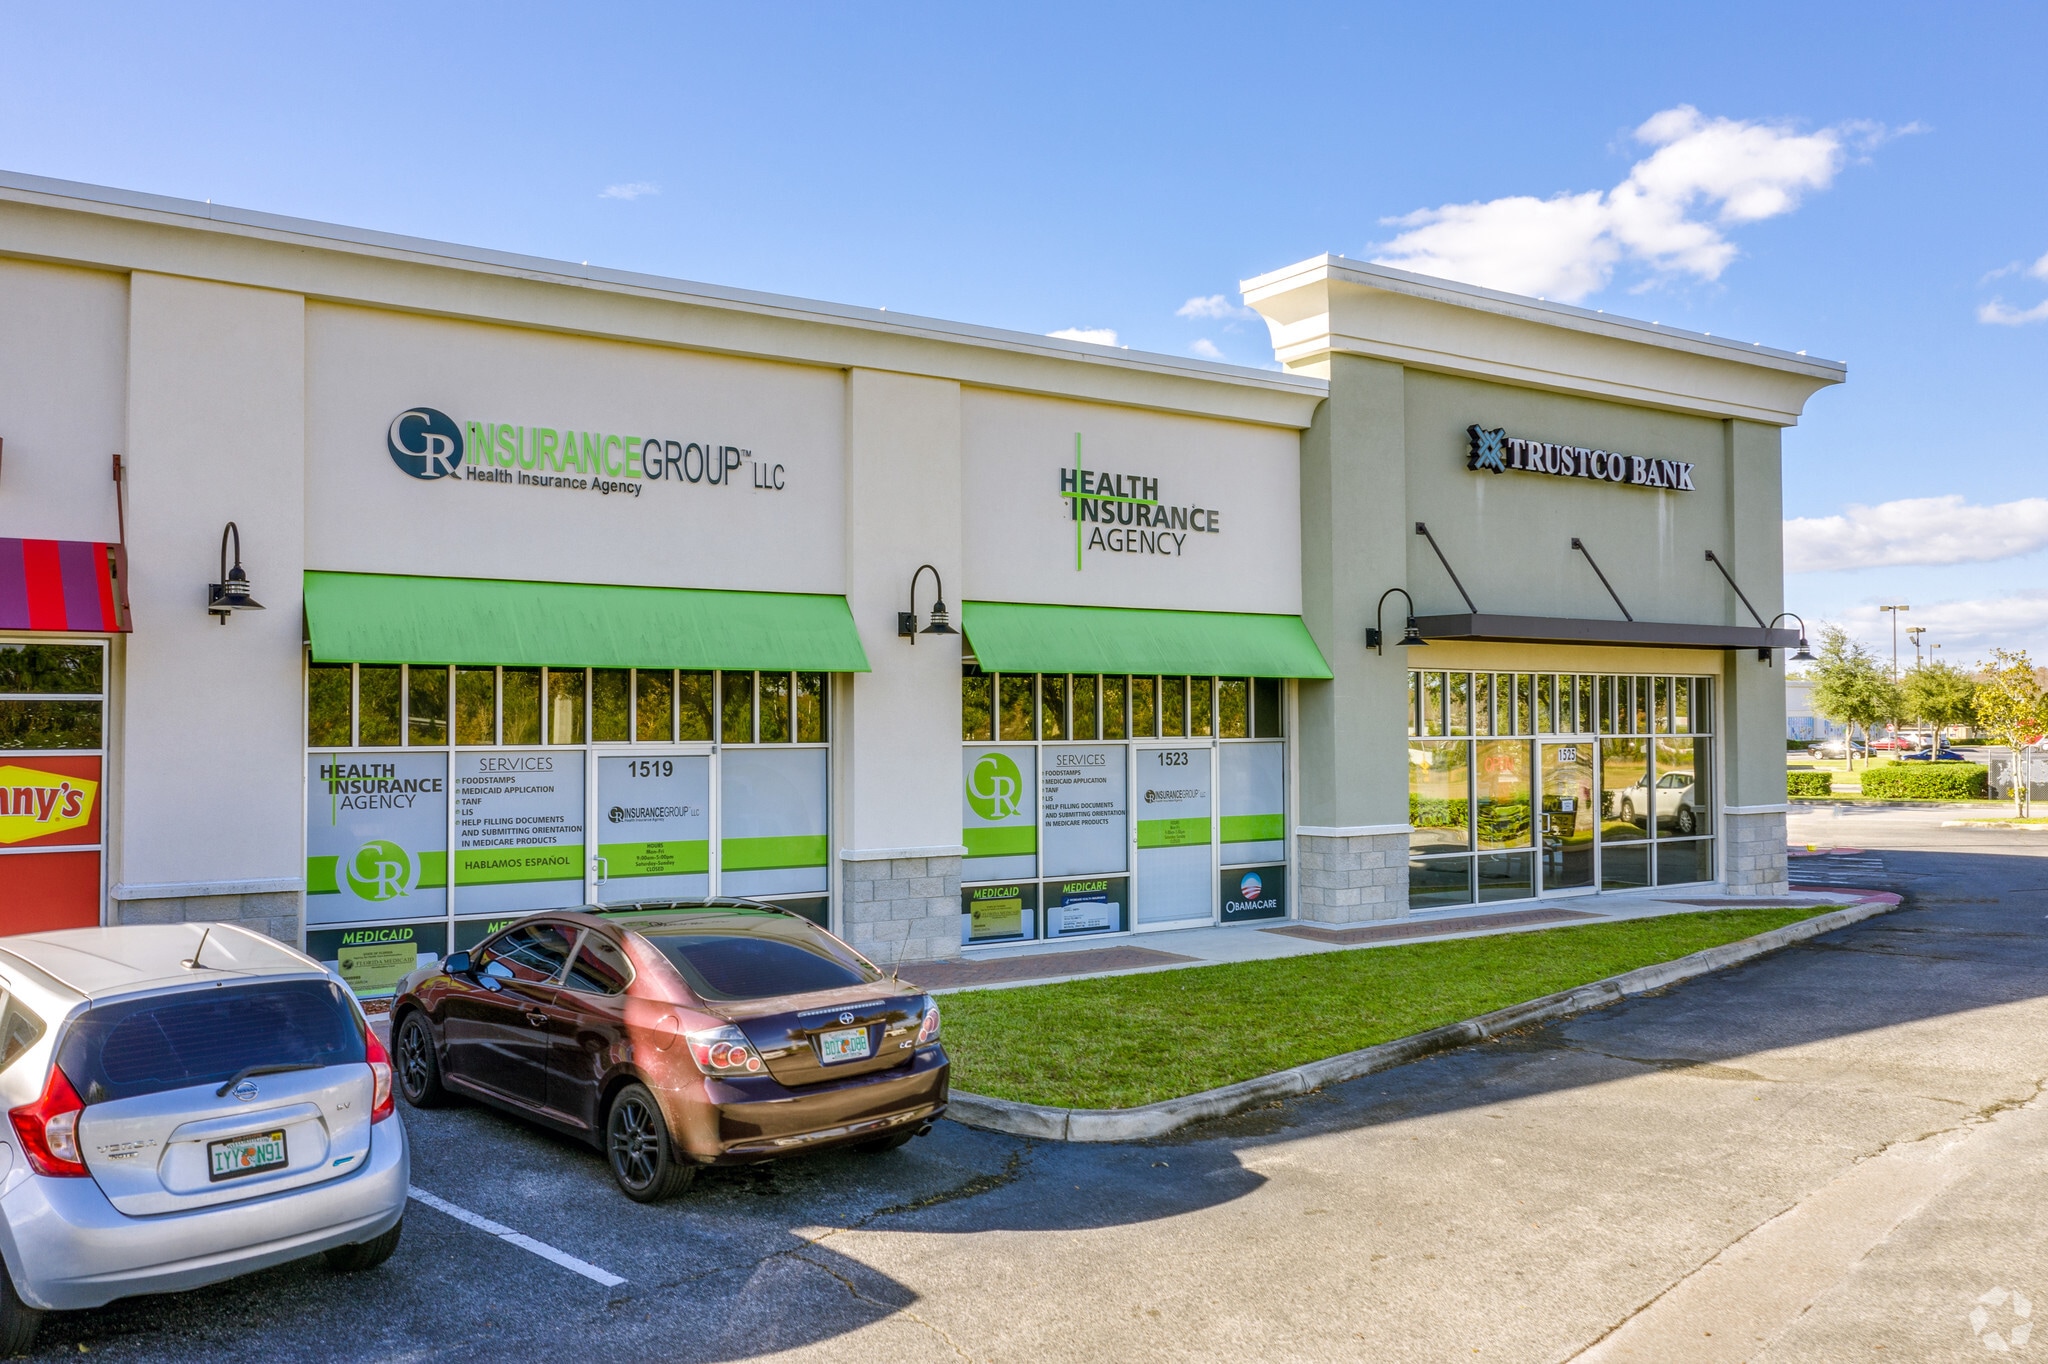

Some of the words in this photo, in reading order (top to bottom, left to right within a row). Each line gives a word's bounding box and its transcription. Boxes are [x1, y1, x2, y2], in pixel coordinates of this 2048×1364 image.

[1505, 437, 1627, 482] TRUSTCO
[1629, 455, 1696, 491] BANK
[466, 466, 513, 485] Health
[518, 470, 588, 491] Insurance
[592, 476, 643, 498] Agency
[754, 462, 786, 491] LLC
[1060, 467, 1158, 501] HEALTH
[1071, 495, 1220, 533] INSURANCE
[1088, 526, 1187, 556] AGENCY
[1056, 754, 1106, 766] SERVICES
[1158, 752, 1189, 766] 1523
[1559, 749, 1576, 761] 1525
[320, 764, 395, 779] HEALTH
[479, 757, 553, 771] SERVICES
[628, 760, 674, 778] 1519
[1484, 756, 1515, 772] OPEN
[328, 778, 443, 795] INSURANCE
[461, 776, 516, 785] FOODSTAMPS
[461, 787, 502, 795] MEDICAID
[504, 785, 555, 794] APPLICATION
[340, 794, 417, 810] AGENCY
[1081, 801, 1114, 809] DOCUMENTS
[483, 817, 514, 825] FILLING
[515, 816, 565, 824] DOCUMENTS
[461, 829, 480, 837] AND
[481, 827, 530, 836] SUBMITTING
[532, 825, 583, 834] ORIENTATION
[473, 838, 514, 847] MEDICARE
[516, 836, 557, 845] PRODUCTS
[464, 859, 522, 870] HABLAMOS
[525, 855, 570, 867] ESPAÑOL
[973, 886, 1020, 899] MEDICAID
[1062, 880, 1108, 893] MEDICARE
[342, 928, 414, 944] MEDICAID
[96, 1139, 158, 1153] VERSA
[215, 1148, 240, 1172] IYY
[257, 1141, 283, 1163] N91
